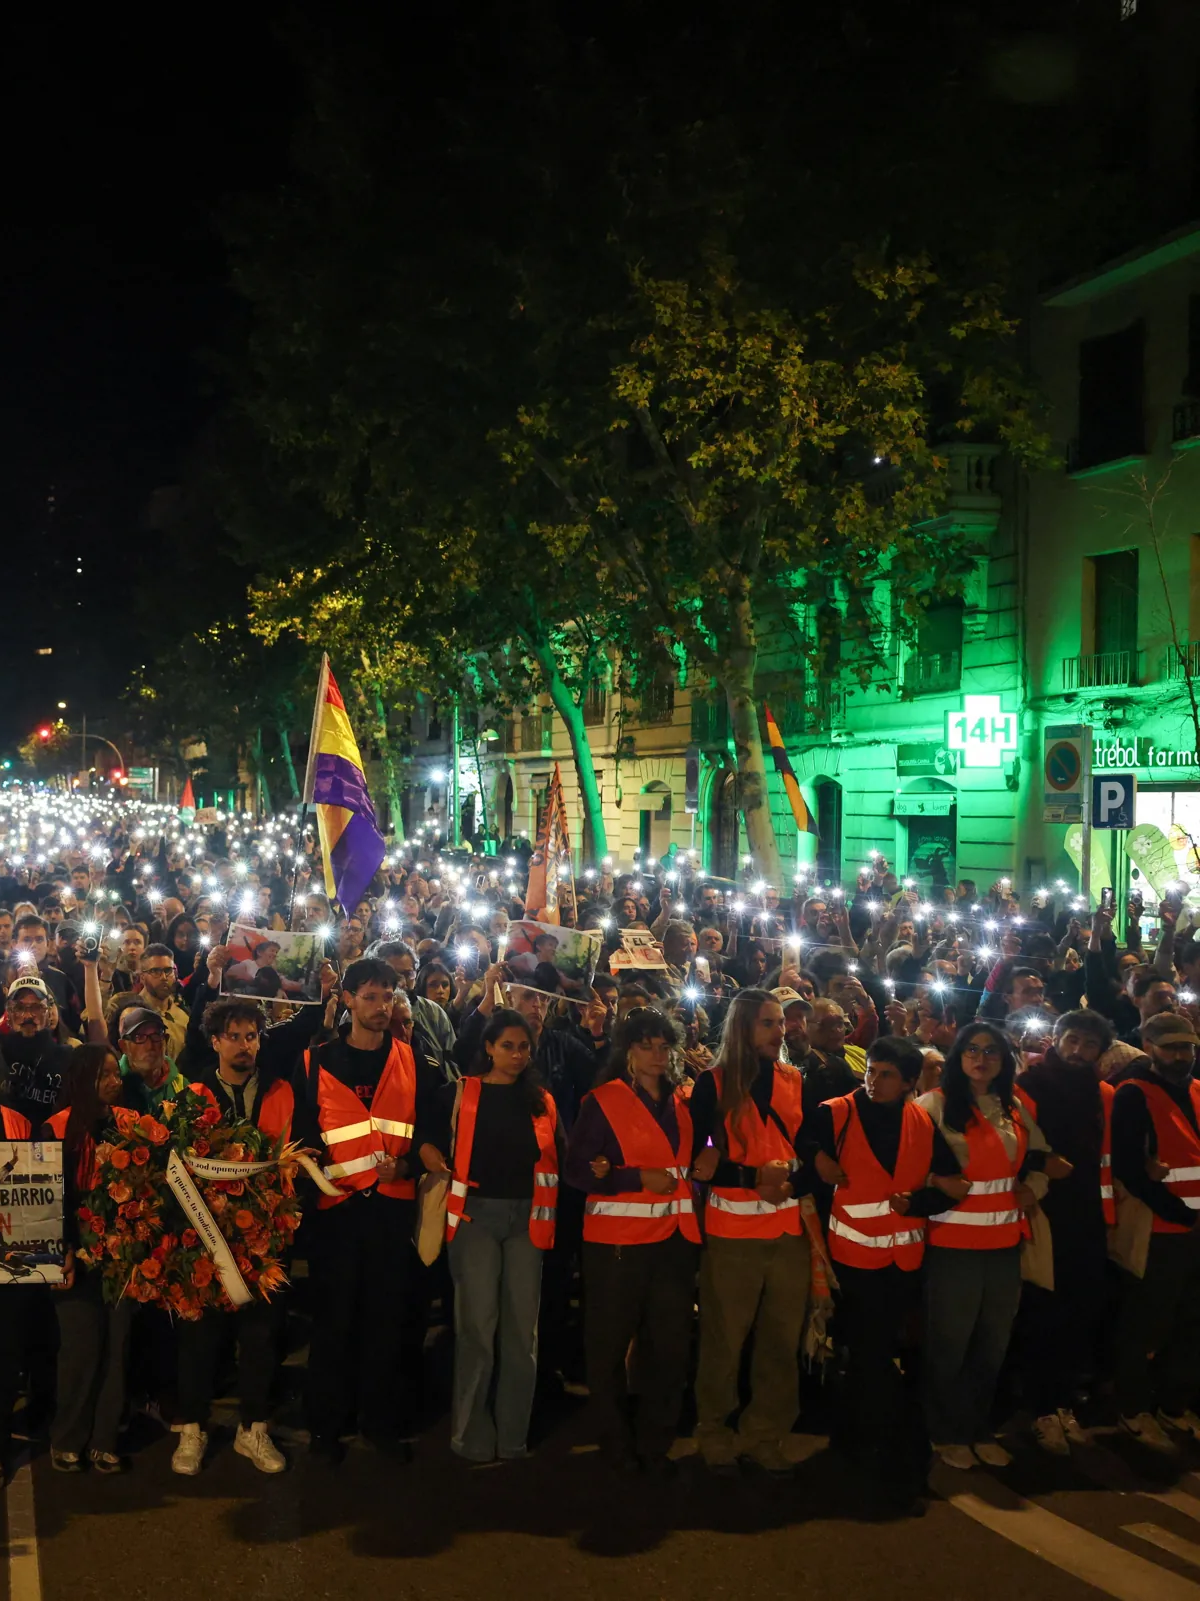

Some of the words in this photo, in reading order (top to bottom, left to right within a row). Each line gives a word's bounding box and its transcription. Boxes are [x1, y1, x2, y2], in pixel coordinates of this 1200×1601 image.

[955, 717, 1011, 743] 14H
[1095, 737, 1140, 767] trébol
[0, 1188, 55, 1207] BARRIO
[169, 1163, 177, 1177] Te
[190, 1201, 198, 1212] tu
